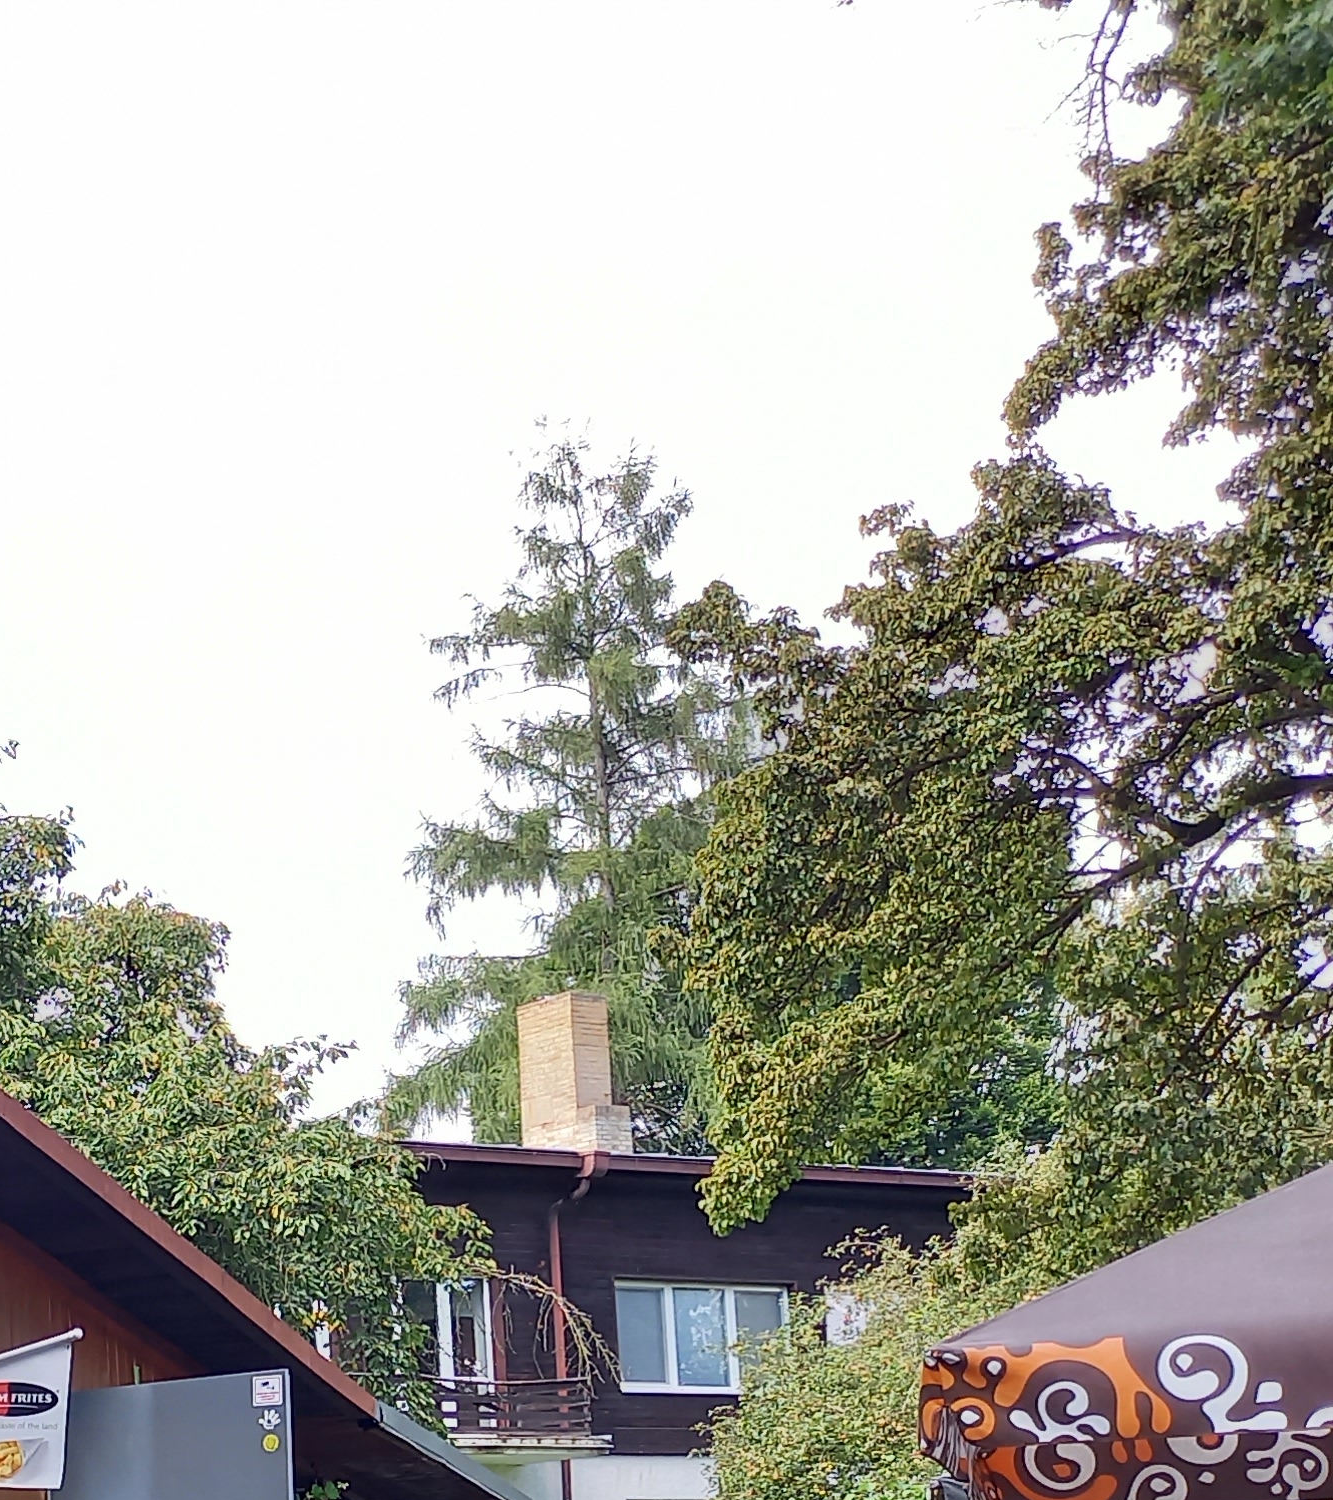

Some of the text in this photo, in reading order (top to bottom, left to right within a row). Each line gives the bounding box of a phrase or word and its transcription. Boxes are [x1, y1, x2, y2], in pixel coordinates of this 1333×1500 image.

[10, 1392, 53, 1404] FRITES
[27, 1421, 40, 1430] the
[41, 1422, 59, 1431] land
